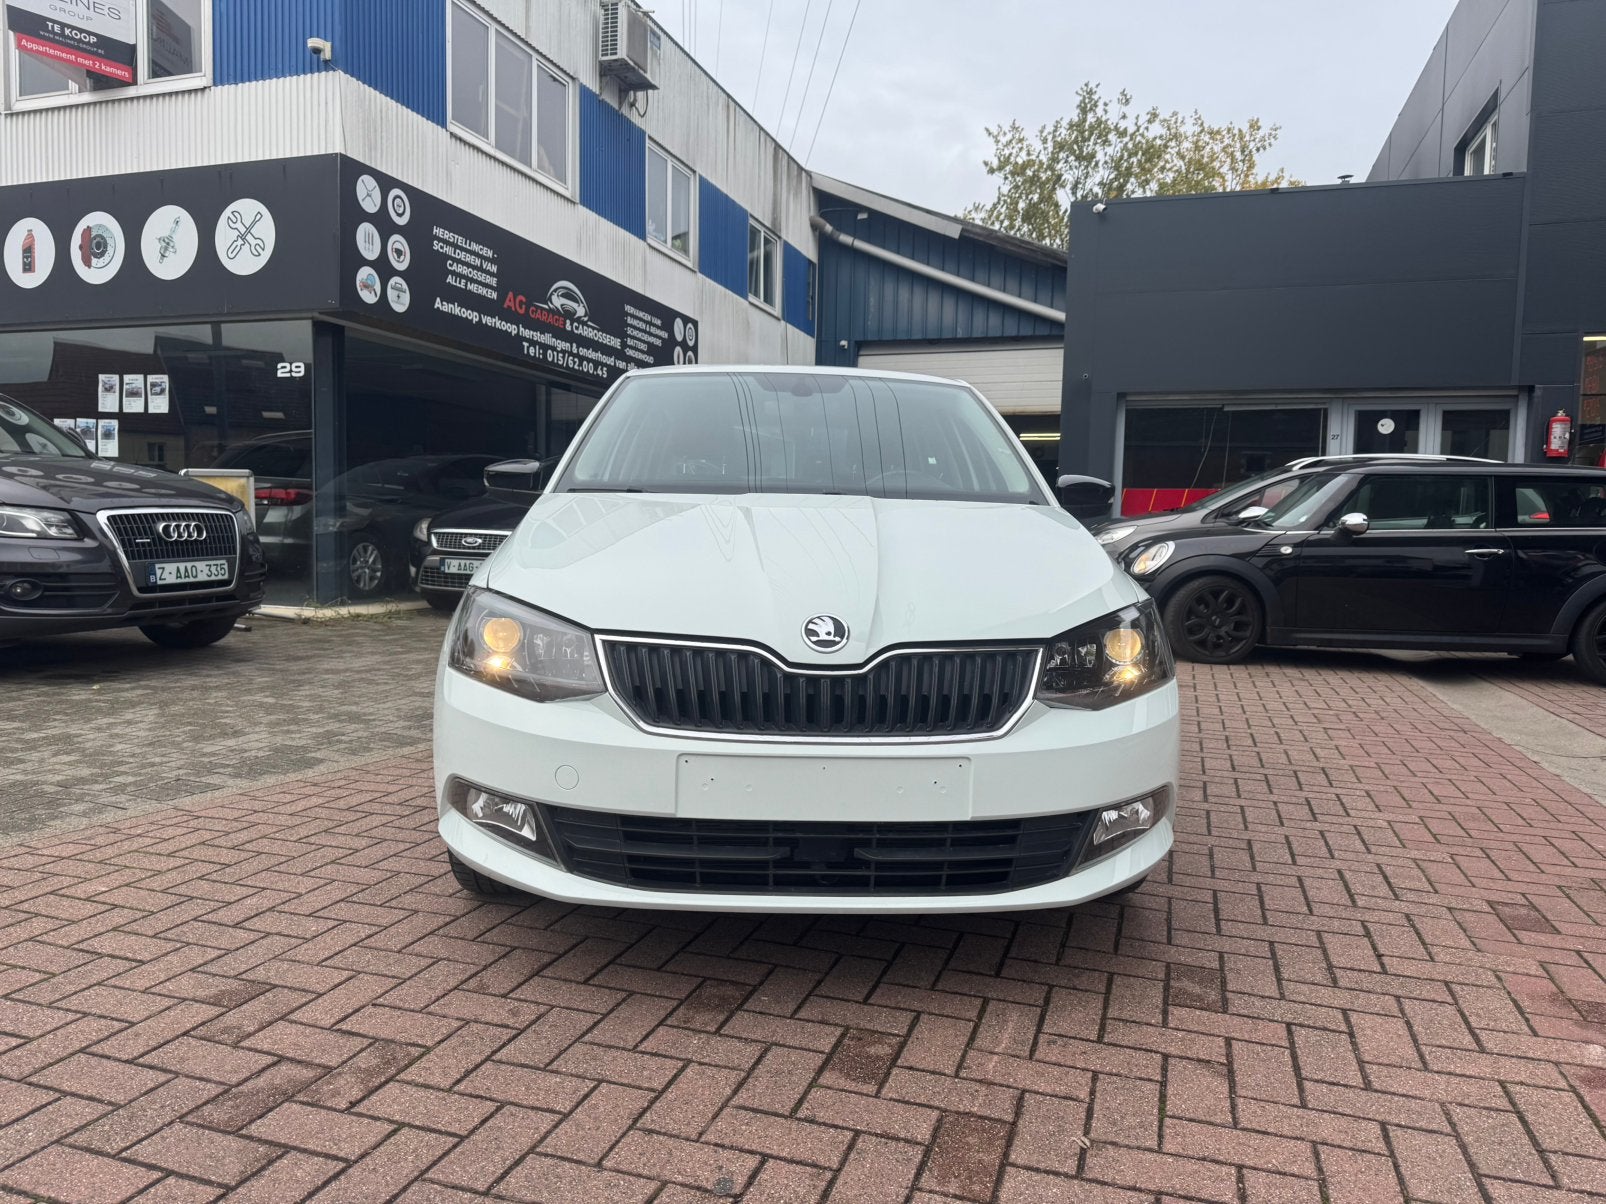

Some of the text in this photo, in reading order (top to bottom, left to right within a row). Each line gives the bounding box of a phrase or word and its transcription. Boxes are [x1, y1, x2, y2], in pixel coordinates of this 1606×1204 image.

[48, 4, 94, 21] GROUP
[46, 21, 98, 44] TE KOOP
[21, 39, 129, 78] Appartement met 2 kamers
[433, 225, 493, 259] HERSTELLINGEN
[433, 240, 497, 274] SCHILDEREN VAN
[446, 260, 498, 287] CARROSSERIE
[446, 274, 498, 300] ALLE MERKEN
[503, 291, 622, 349] AG GARAGE & CARROSSERIE
[624, 304, 651, 322] VERVANGEN
[434, 297, 479, 324] Aankoop
[481, 314, 518, 336] verkoop
[519, 324, 571, 351] herstellingen
[571, 343, 578, 354] &
[578, 347, 614, 367] onderhoud
[615, 359, 627, 370] van
[277, 362, 305, 377] 29
[522, 341, 608, 378] Tel: 015/62.00.45
[446, 561, 483, 572] V-AAG-
